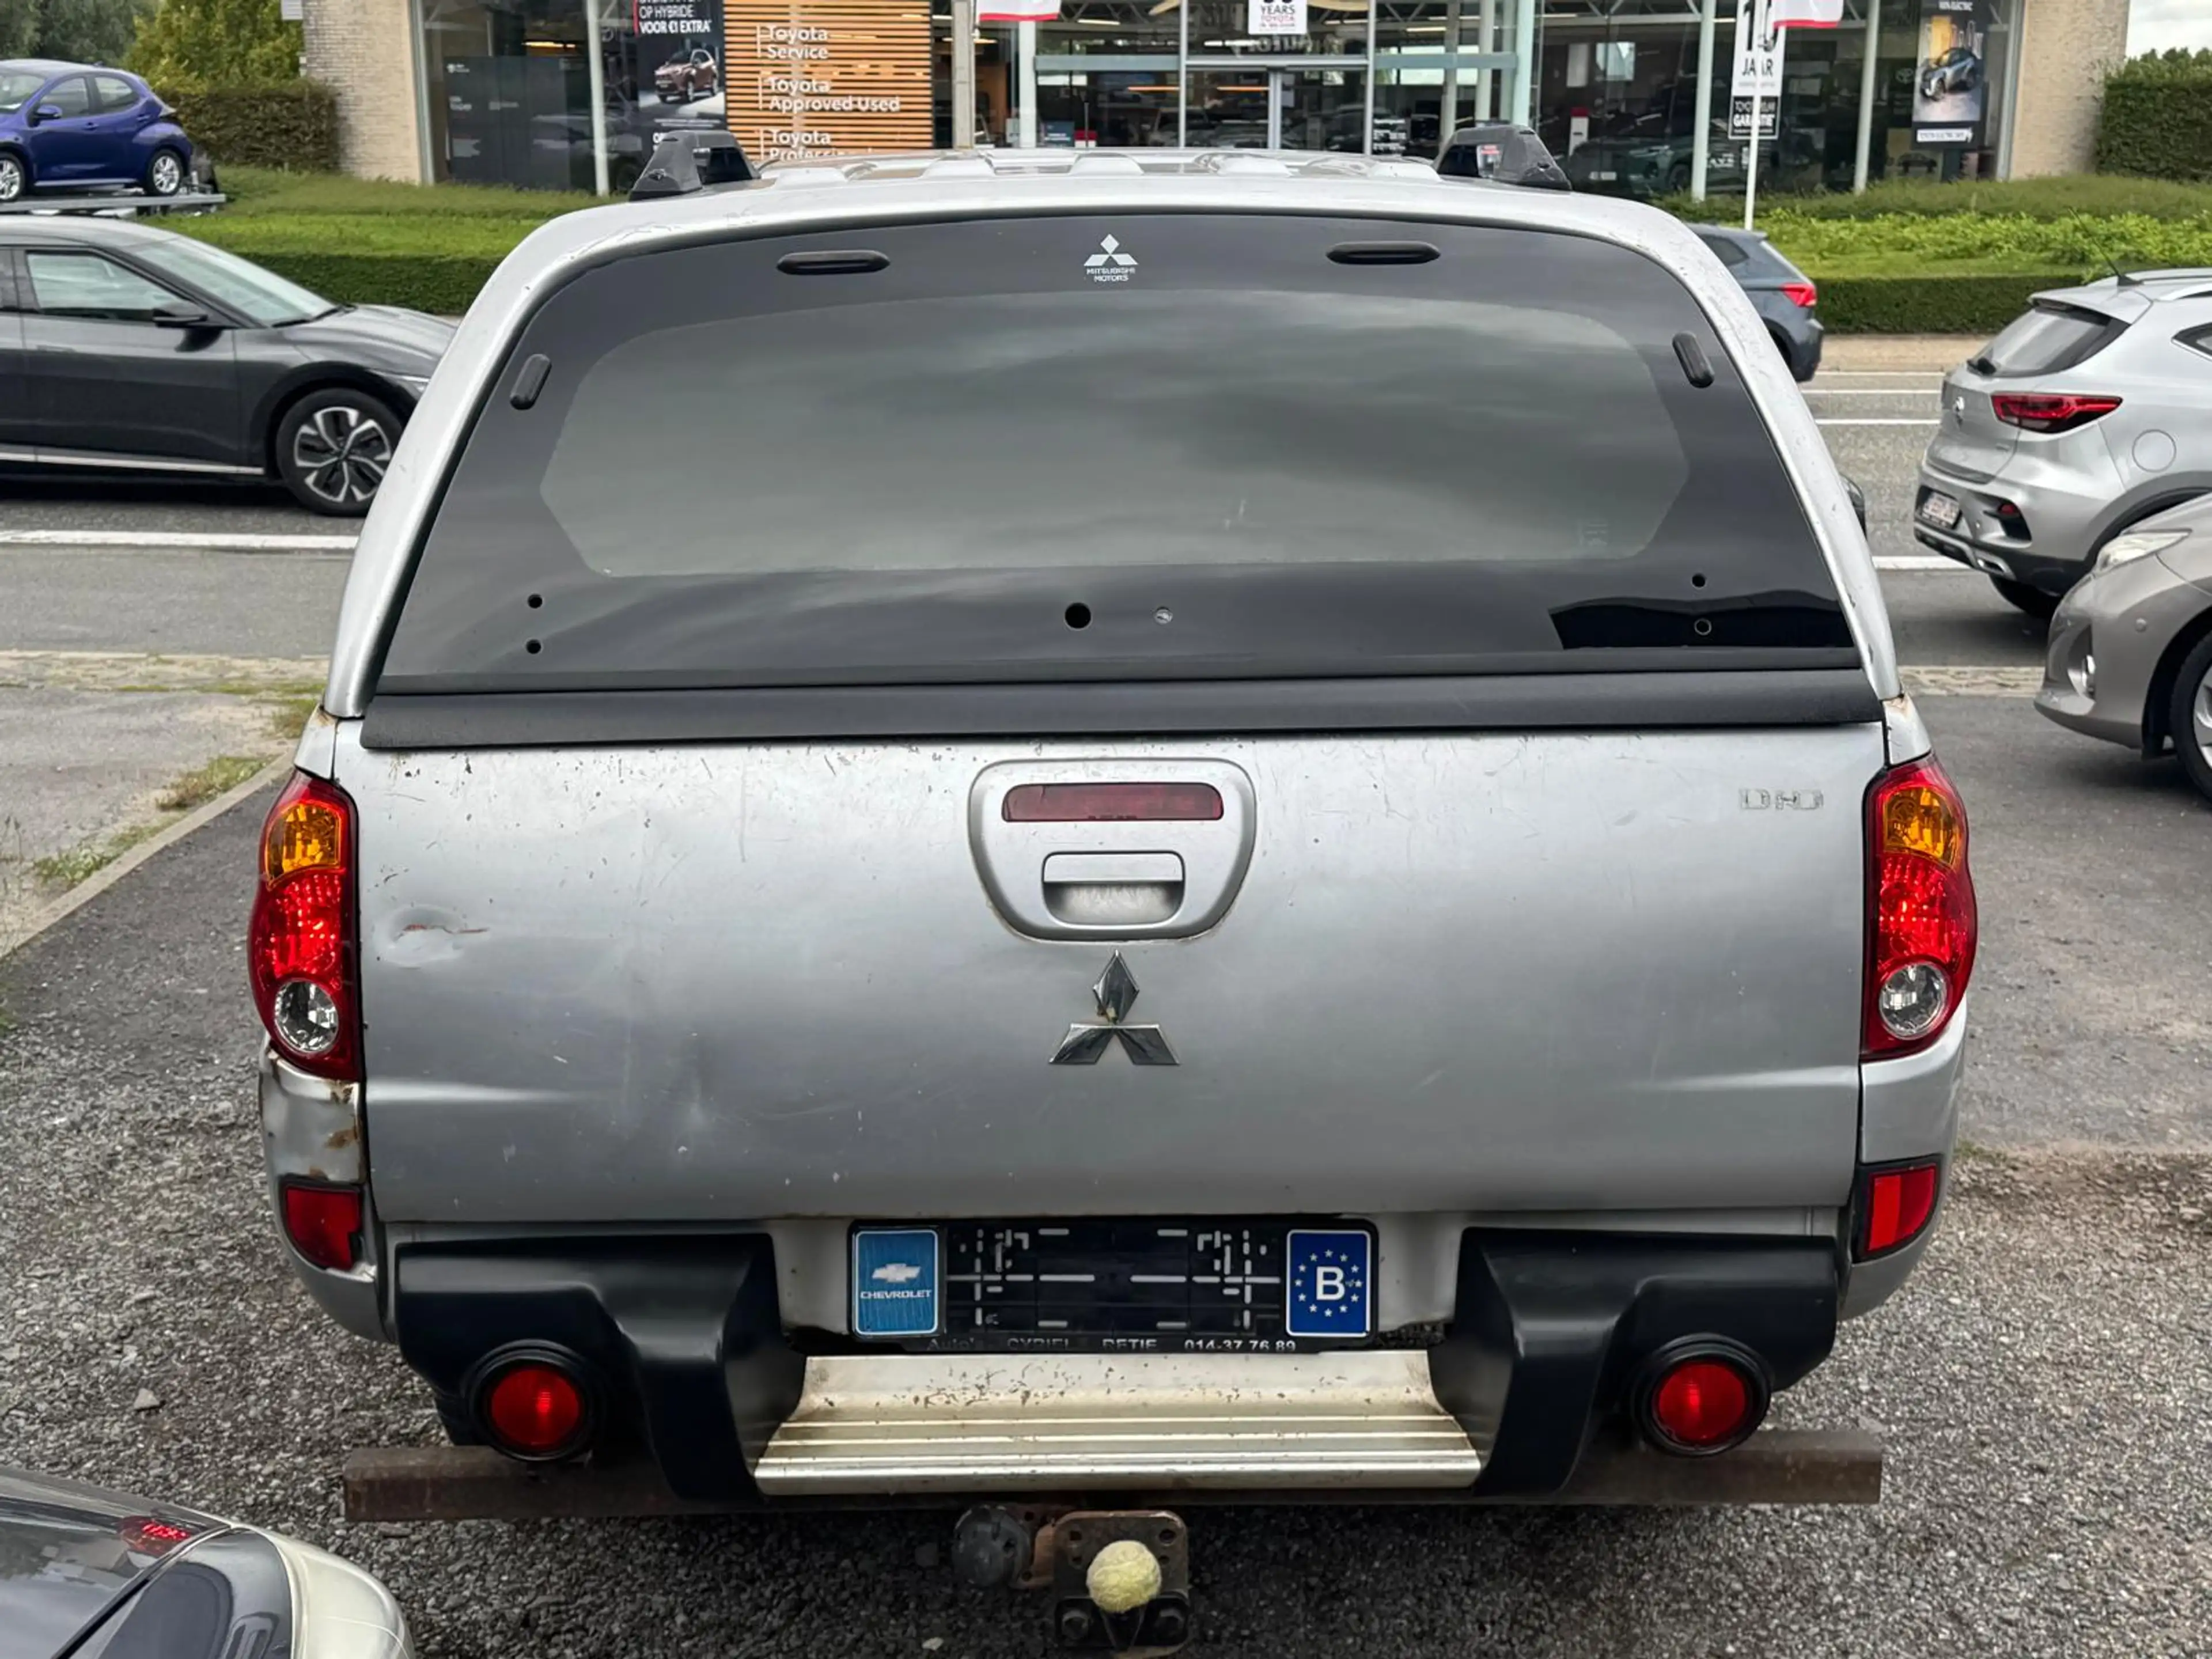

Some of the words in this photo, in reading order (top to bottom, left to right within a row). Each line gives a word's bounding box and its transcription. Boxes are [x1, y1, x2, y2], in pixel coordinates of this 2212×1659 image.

[639, 6, 653, 19] OP
[655, 5, 694, 18] HYBRIDE
[1260, 5, 1295, 14] YEARS
[639, 21, 667, 33] VOOR
[767, 25, 828, 44] Toyota
[768, 44, 829, 59] Service
[768, 77, 830, 96] Toyota
[769, 96, 853, 114] Approved
[858, 96, 900, 112] Used
[770, 129, 831, 147] Toyota
[1317, 1266, 1345, 1300] B
[860, 1290, 932, 1299] CHEVROLET
